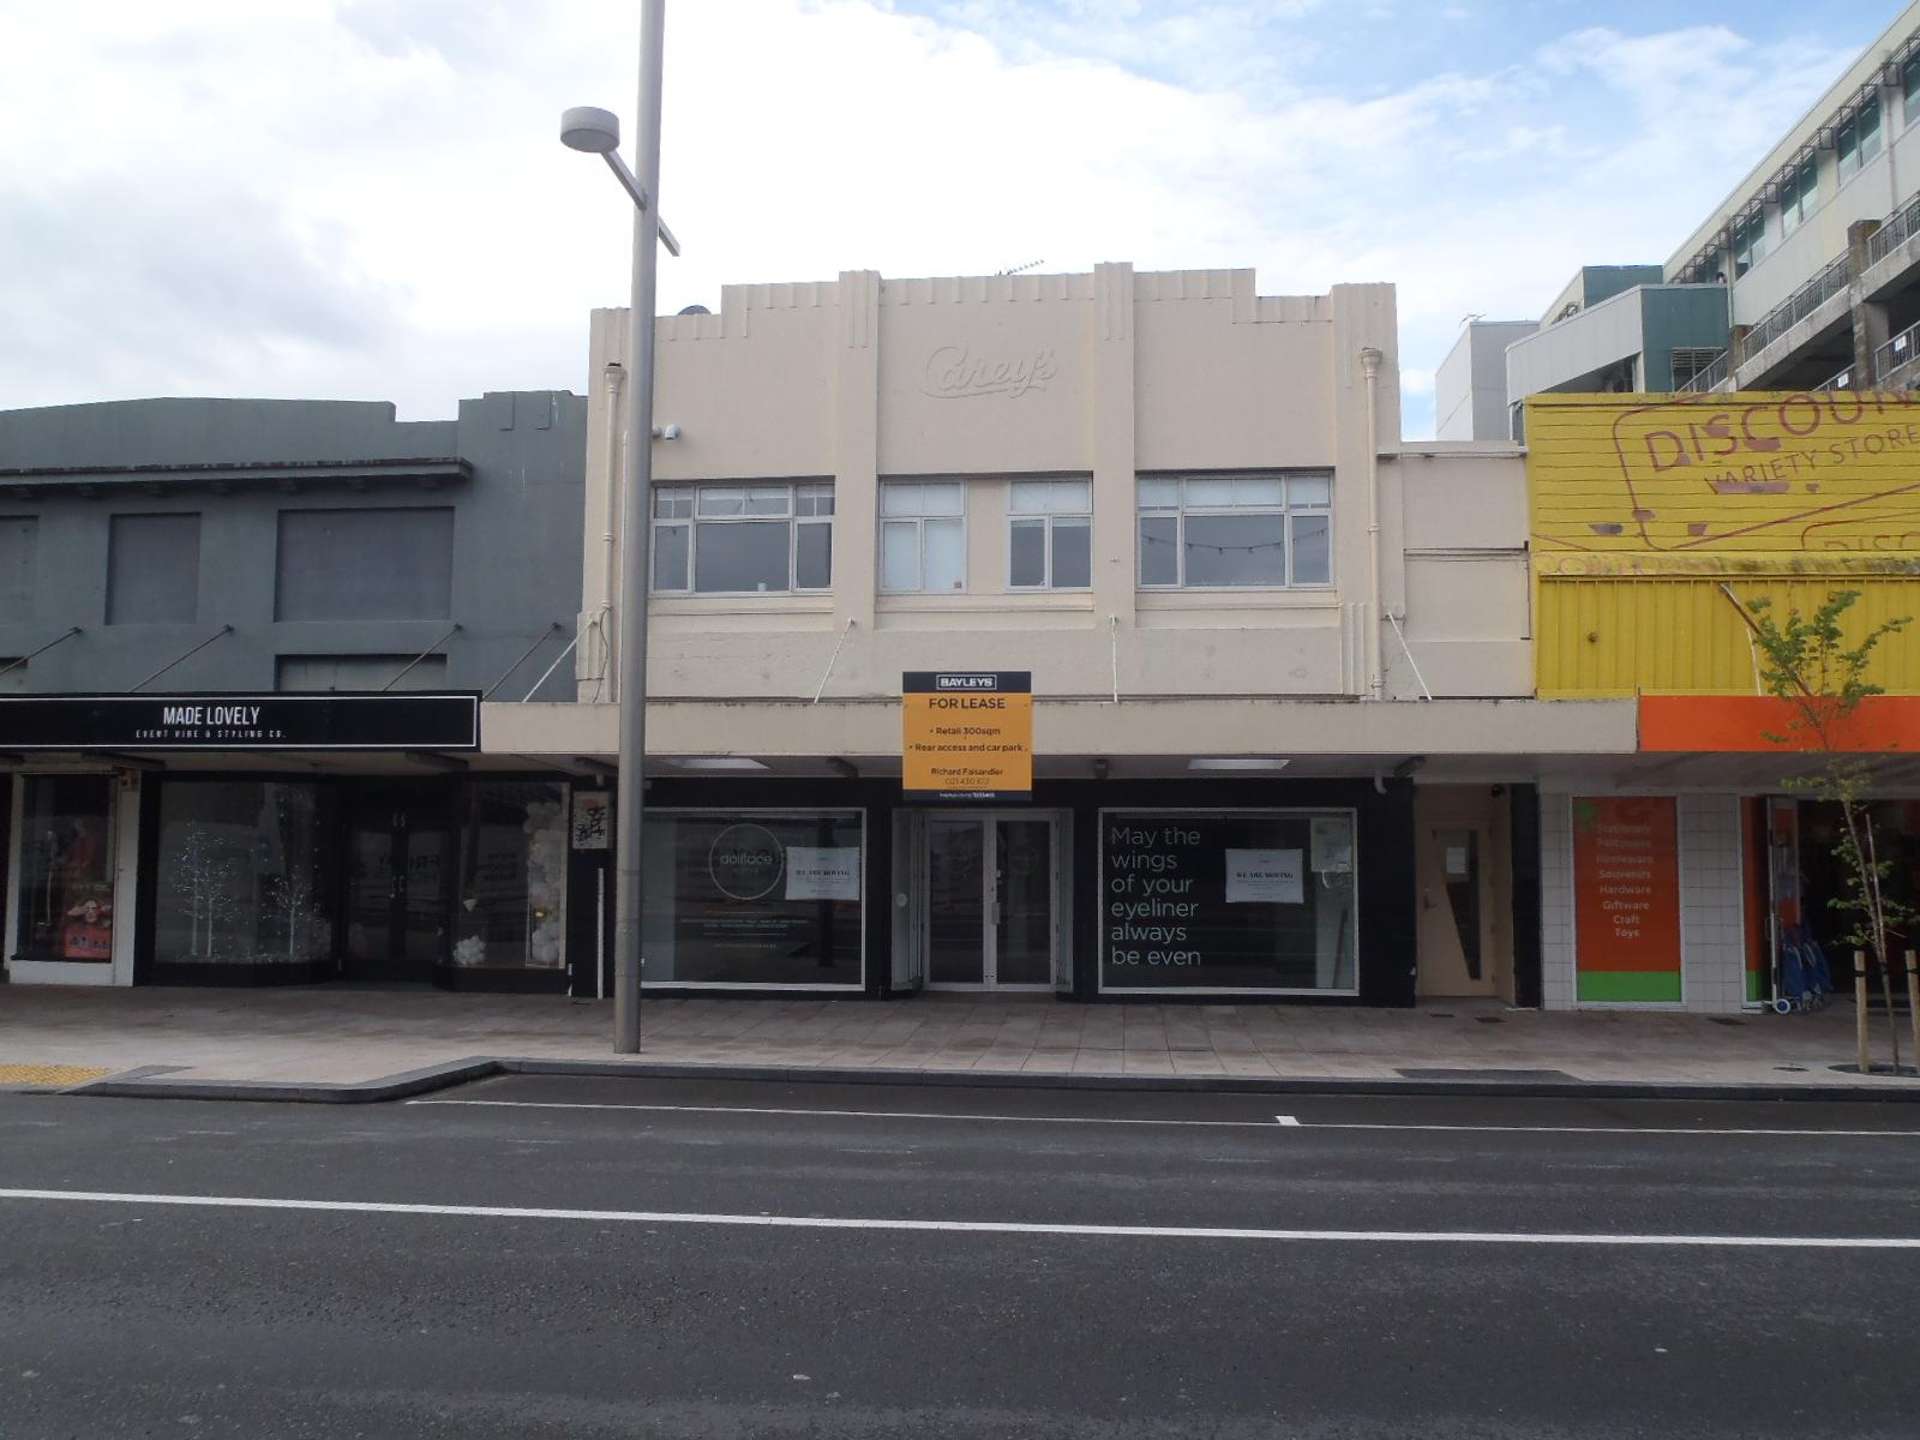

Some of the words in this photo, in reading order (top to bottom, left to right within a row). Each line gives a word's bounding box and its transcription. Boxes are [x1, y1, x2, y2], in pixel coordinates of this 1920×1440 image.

[1704, 449, 1817, 495] VARIETY
[1829, 425, 1920, 464] STORE
[940, 677, 993, 688] BAYLEYS
[928, 698, 958, 709] FOR
[961, 698, 1006, 709] LEASE
[163, 706, 203, 725] MADE
[206, 706, 261, 725] LOVELY
[135, 729, 169, 738] EVENT
[174, 729, 199, 738] HIRE
[217, 729, 263, 738] STYLING
[935, 727, 961, 735] Retail
[963, 727, 1000, 737] 300sqm
[914, 743, 936, 752] Rear
[937, 744, 967, 752] access
[968, 743, 985, 752] and
[1001, 743, 1023, 754] park
[930, 767, 961, 775] Richard
[1111, 826, 1157, 848] May
[1163, 826, 1201, 845] the
[1111, 850, 1178, 873] wings
[1265, 871, 1294, 879] MOVING
[1599, 870, 1651, 879] Souvenirs
[1111, 876, 1137, 893] of
[1142, 878, 1194, 897] your
[1599, 885, 1652, 894] Hardware
[1111, 899, 1199, 921] eyeliner
[1602, 900, 1650, 910] Giftware
[1612, 914, 1641, 925] Craft
[1111, 923, 1187, 945] always
[1614, 928, 1641, 939] Toys
[1112, 946, 1140, 966] be
[1147, 950, 1201, 966] even
